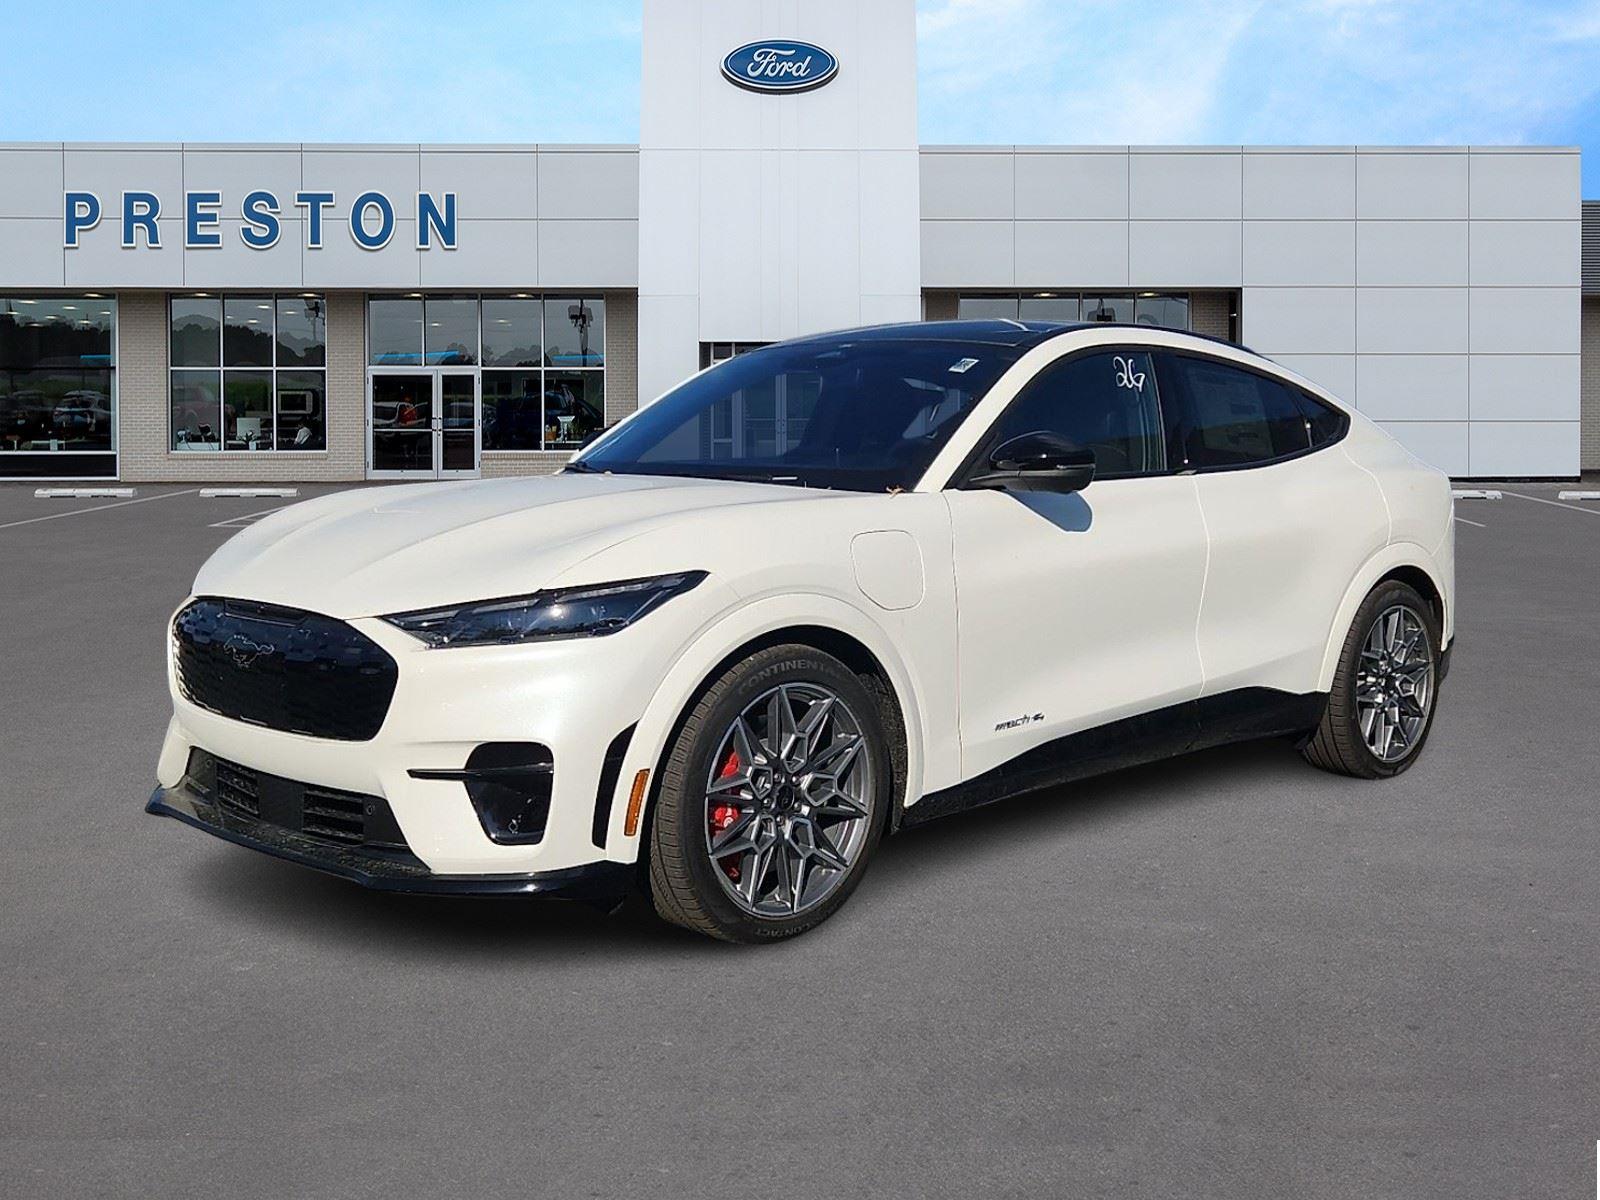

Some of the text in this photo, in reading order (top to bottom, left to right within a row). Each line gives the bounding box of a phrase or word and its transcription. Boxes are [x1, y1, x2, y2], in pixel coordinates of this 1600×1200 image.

[747, 48, 812, 77] Ford
[63, 191, 459, 249] PRESTON
[1113, 356, 1146, 392] 26
[738, 659, 842, 694] CONTINENT
